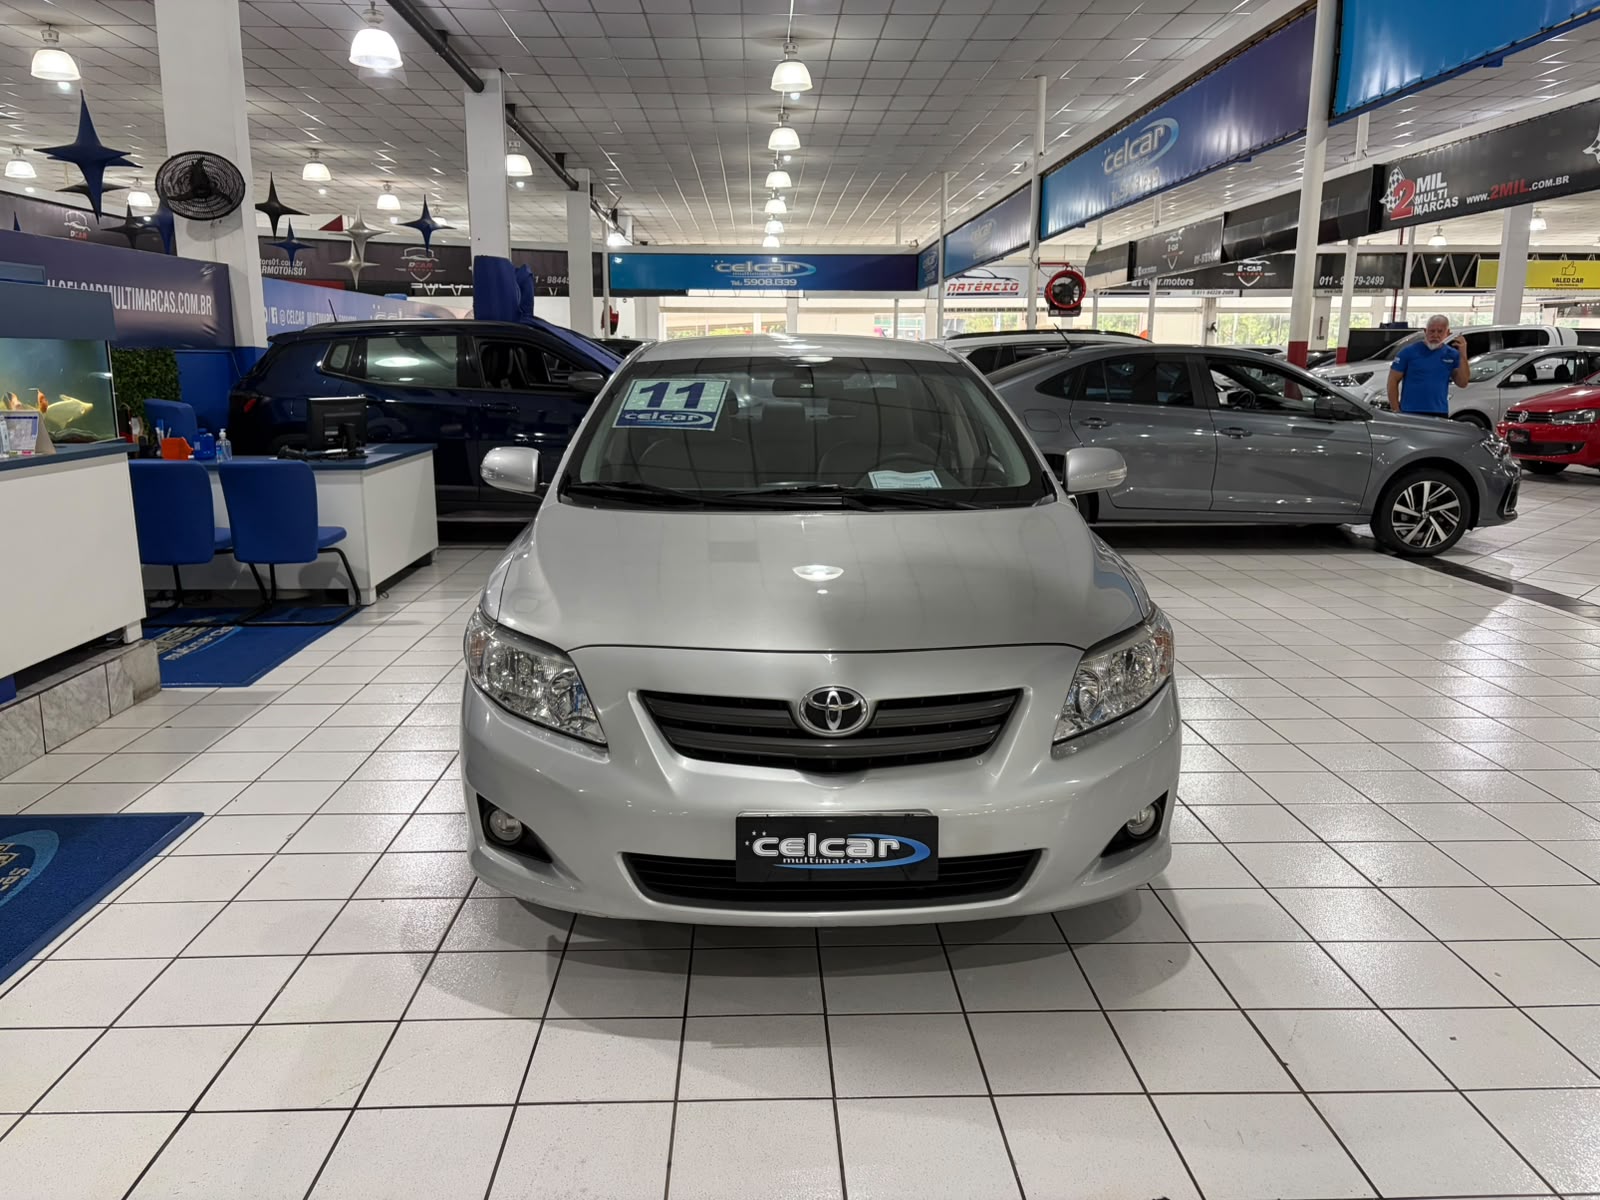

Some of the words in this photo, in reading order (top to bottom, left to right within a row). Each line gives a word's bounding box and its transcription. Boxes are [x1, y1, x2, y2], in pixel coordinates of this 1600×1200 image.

[1103, 126, 1165, 176] celcar
[1390, 179, 1415, 220] 2
[1416, 172, 1447, 193] MIL
[1414, 190, 1448, 206] MULTI
[1413, 196, 1459, 216] MARCAS
[716, 260, 800, 273] celcar
[947, 280, 1019, 291] NATÉRCIO
[1319, 276, 1334, 285] 011
[639, 381, 706, 409] 11
[624, 411, 699, 421] celcar
[752, 832, 901, 858] celcar
[782, 856, 869, 865] multimarcas
